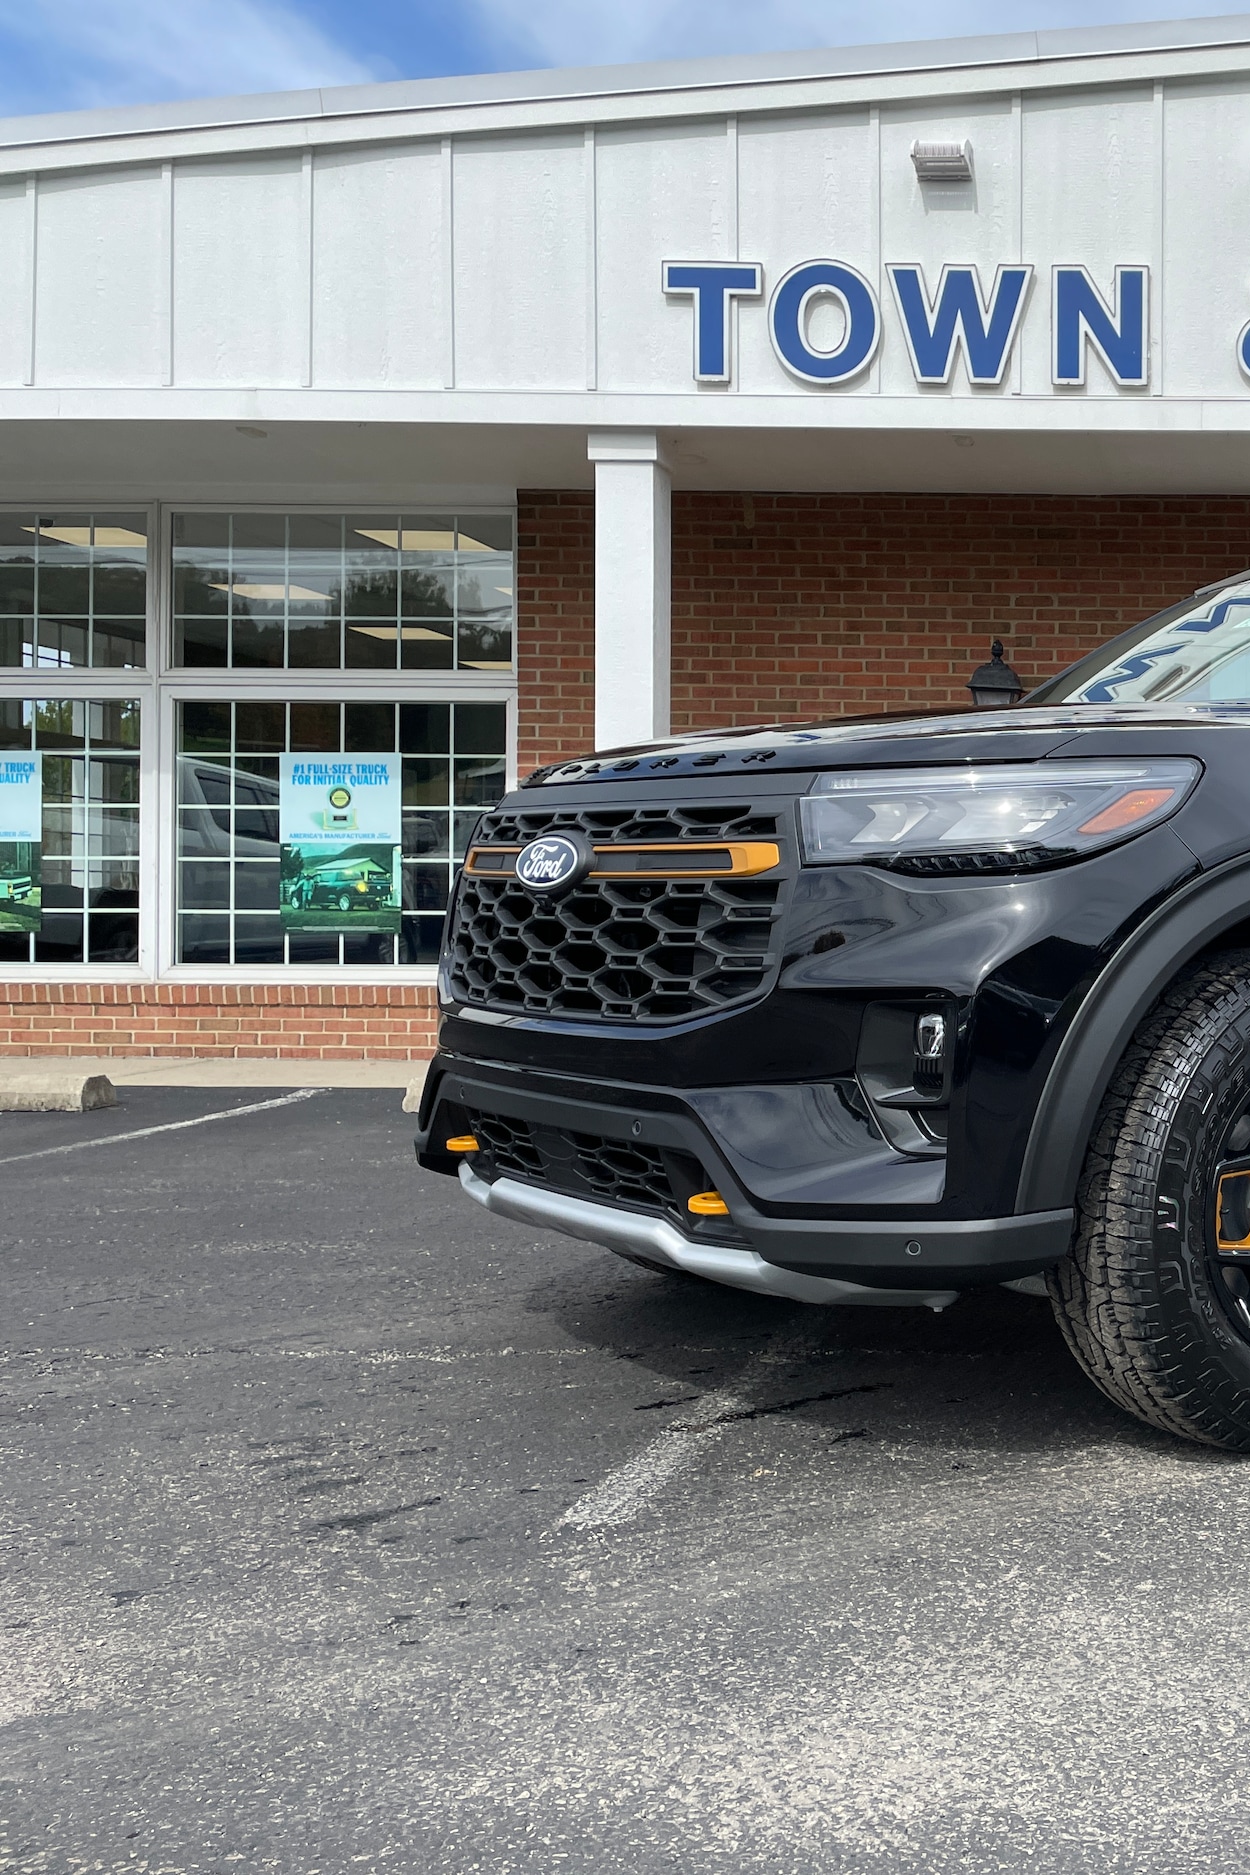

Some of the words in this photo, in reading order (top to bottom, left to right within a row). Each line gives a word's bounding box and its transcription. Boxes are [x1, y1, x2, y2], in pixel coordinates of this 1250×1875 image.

[662, 258, 1150, 385] TOWN
[4, 762, 36, 773] TRUCK
[293, 763, 305, 774] #1
[307, 763, 353, 774] FULL-SIZE
[356, 764, 387, 774] TRUCK
[292, 774, 311, 785] FOR
[313, 774, 348, 786] INITIAL
[350, 774, 390, 787] QUALITY
[522, 842, 567, 880] Ford
